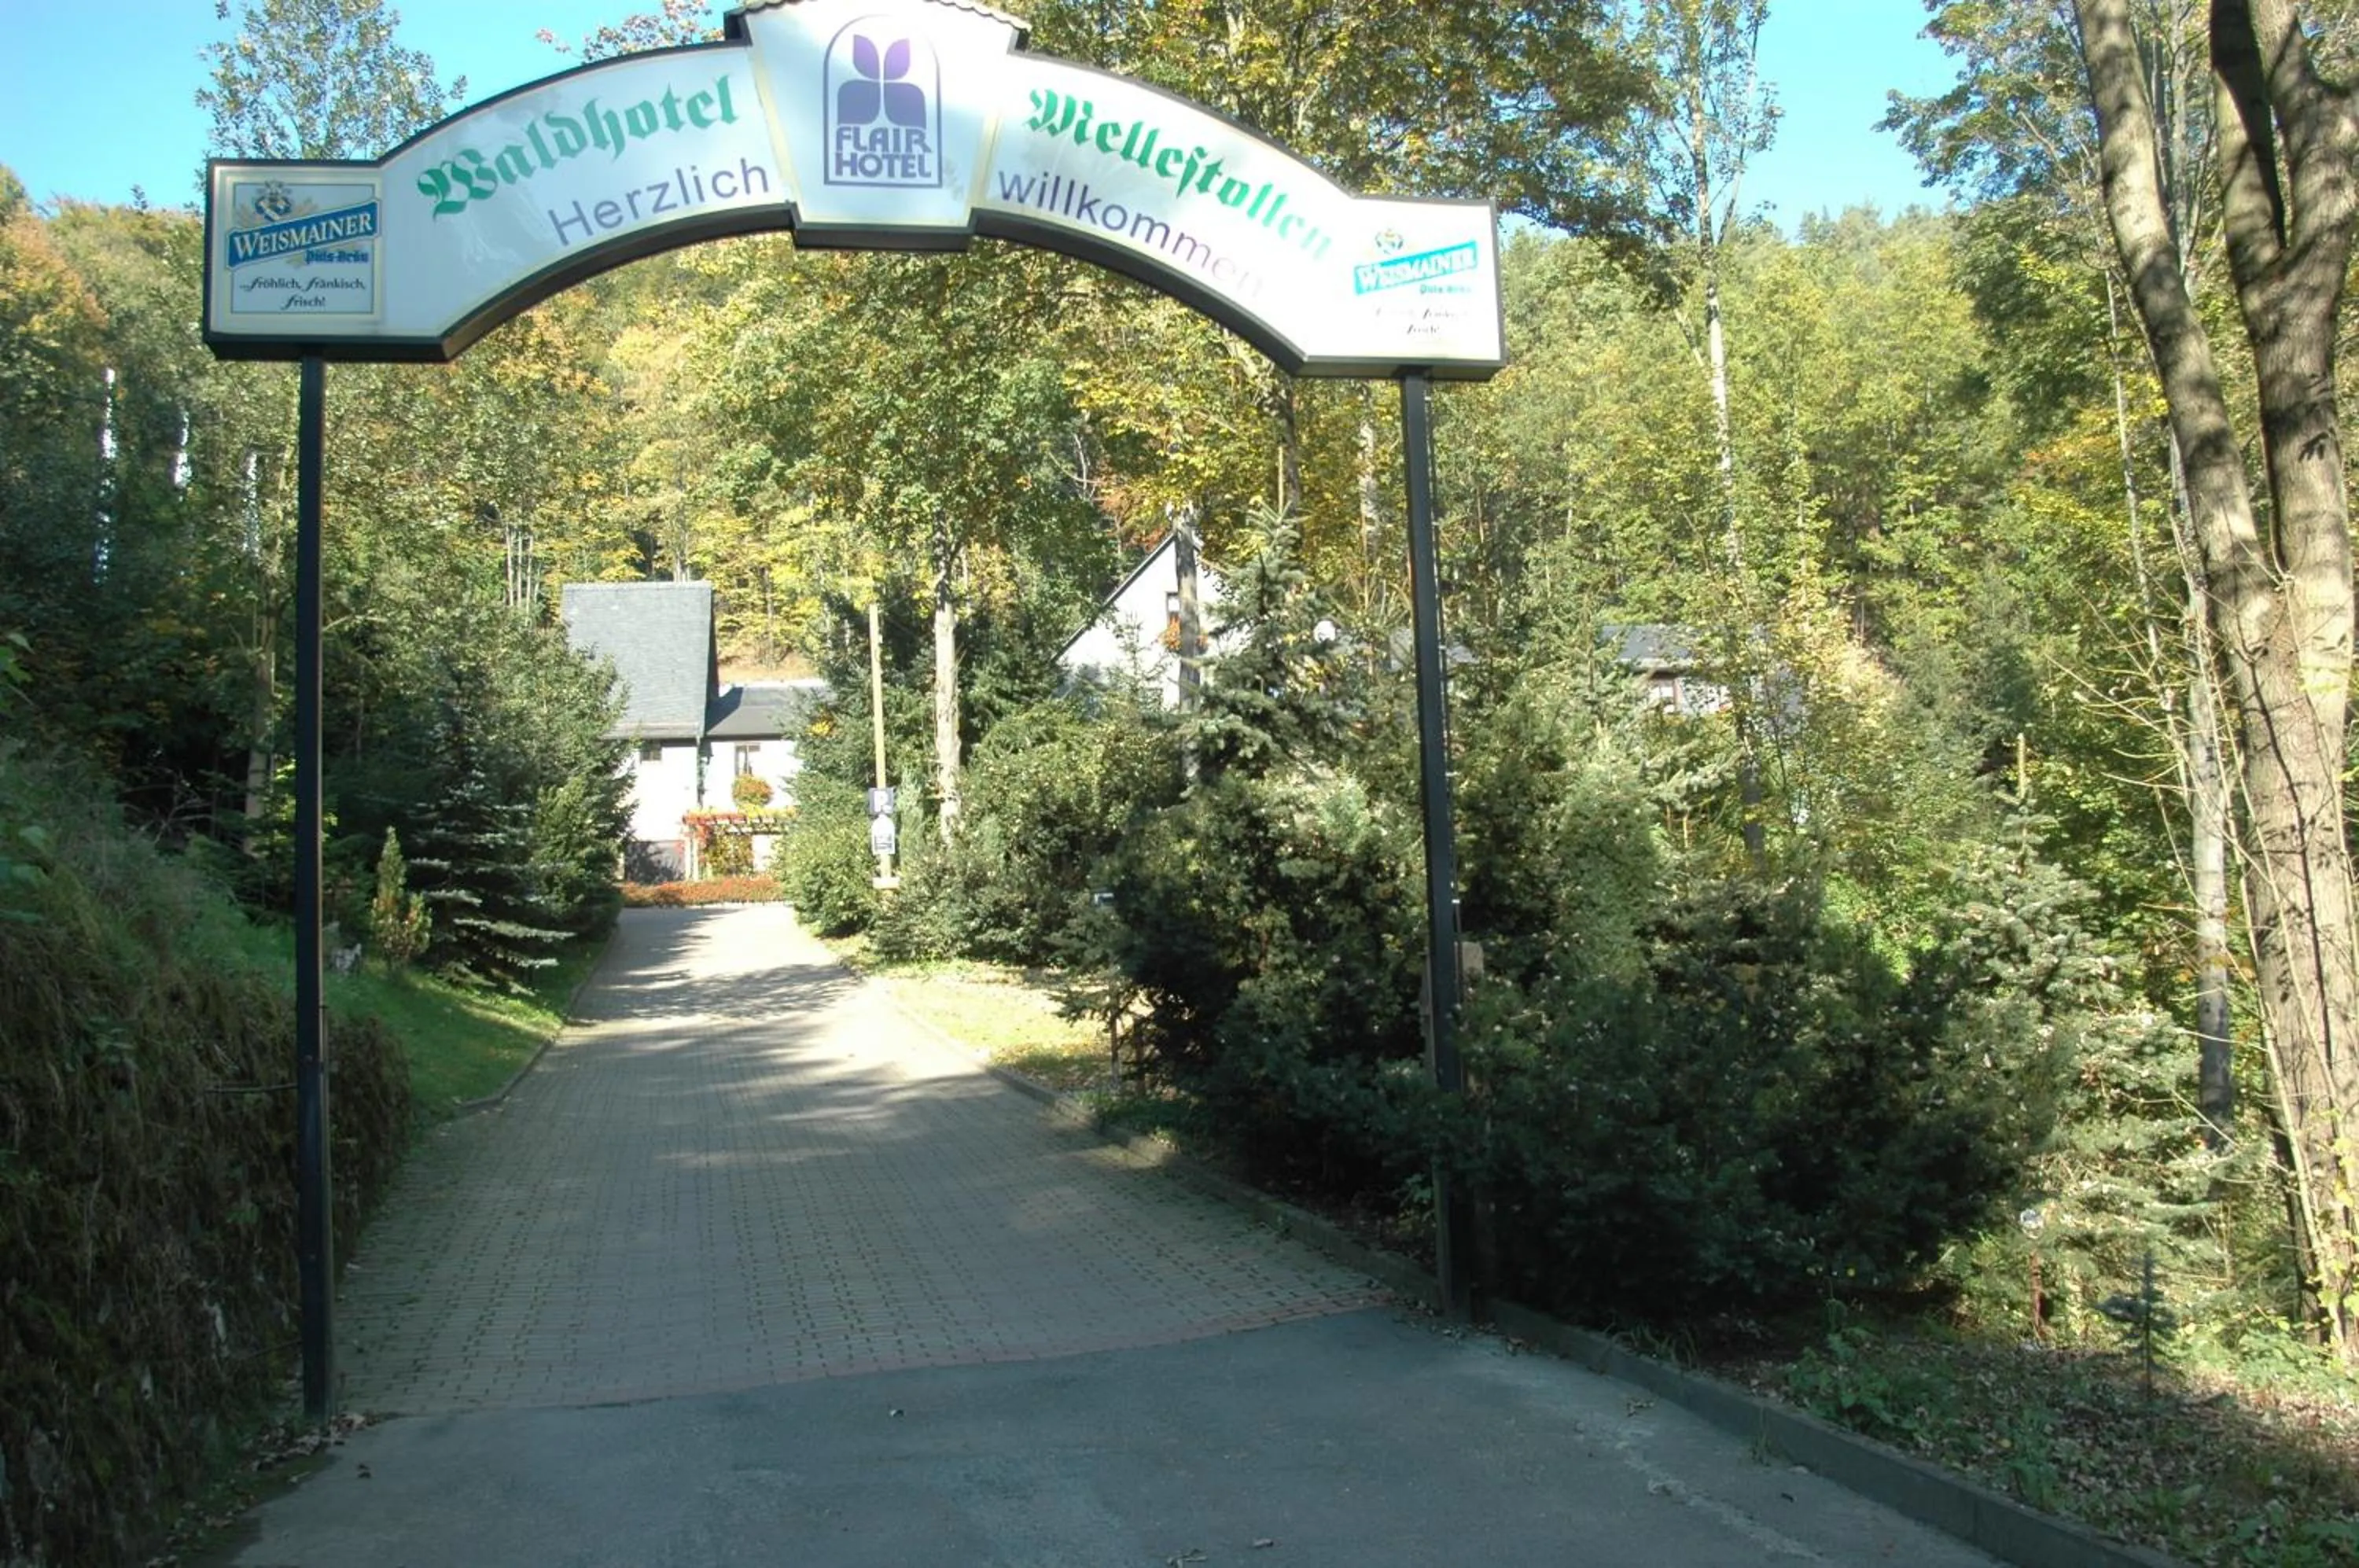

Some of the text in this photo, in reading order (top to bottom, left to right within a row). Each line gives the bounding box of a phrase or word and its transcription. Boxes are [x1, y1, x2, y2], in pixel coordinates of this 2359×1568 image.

[417, 75, 738, 221] Waldhotel
[835, 126, 932, 153] FLAIR
[834, 152, 932, 179] HOTEL
[547, 157, 769, 247] Herzlich
[233, 212, 374, 260] WEISMAINER
[997, 170, 1263, 297] willkommen
[281, 294, 326, 311] frisch!
